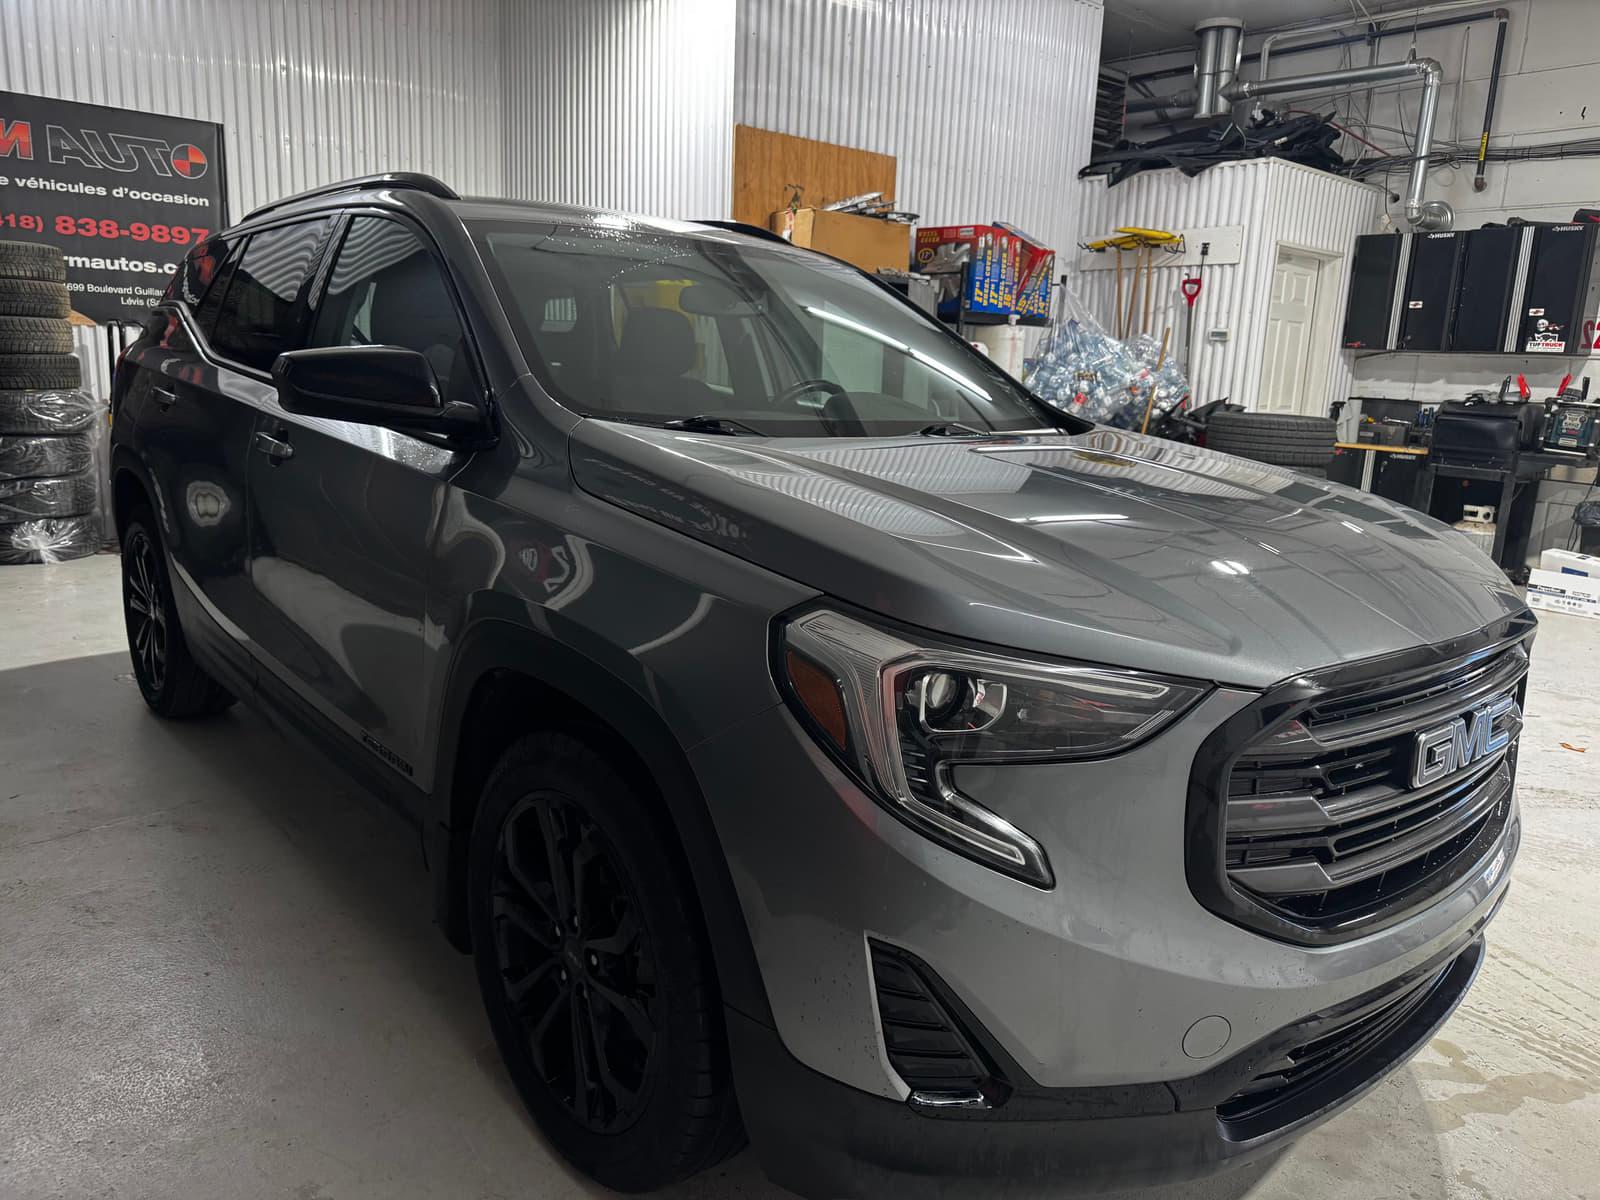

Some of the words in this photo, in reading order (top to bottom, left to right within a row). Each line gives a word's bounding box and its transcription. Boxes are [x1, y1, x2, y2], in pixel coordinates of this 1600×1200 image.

[15, 176, 107, 196] véhicules
[112, 188, 209, 206] d'occasion
[55, 215, 209, 245] 838-9897
[63, 255, 177, 274] mautos.c
[63, 282, 85, 292] 699
[87, 283, 132, 295] Boulevard
[120, 296, 144, 306] Lévis
[1413, 696, 1513, 788] GMC
